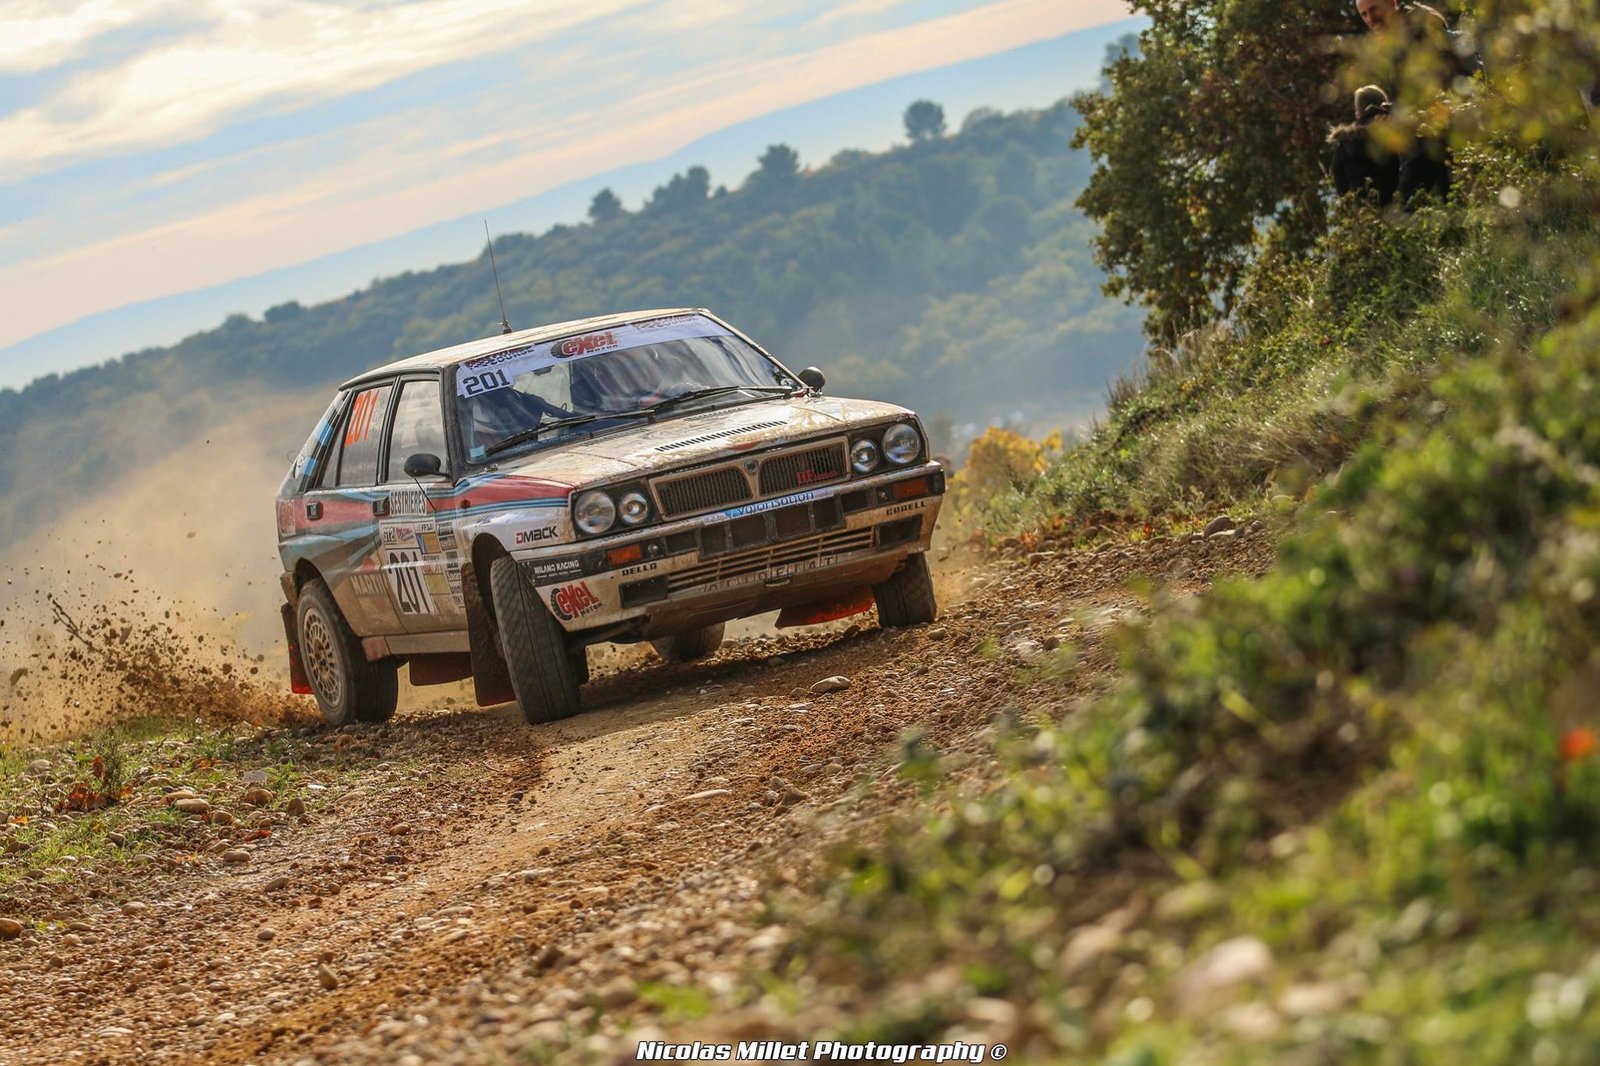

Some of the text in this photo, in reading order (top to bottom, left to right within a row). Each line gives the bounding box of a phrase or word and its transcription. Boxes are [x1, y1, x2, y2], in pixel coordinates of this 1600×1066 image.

[463, 369, 510, 395] 201
[345, 389, 379, 446] 201
[388, 551, 431, 614] 201
